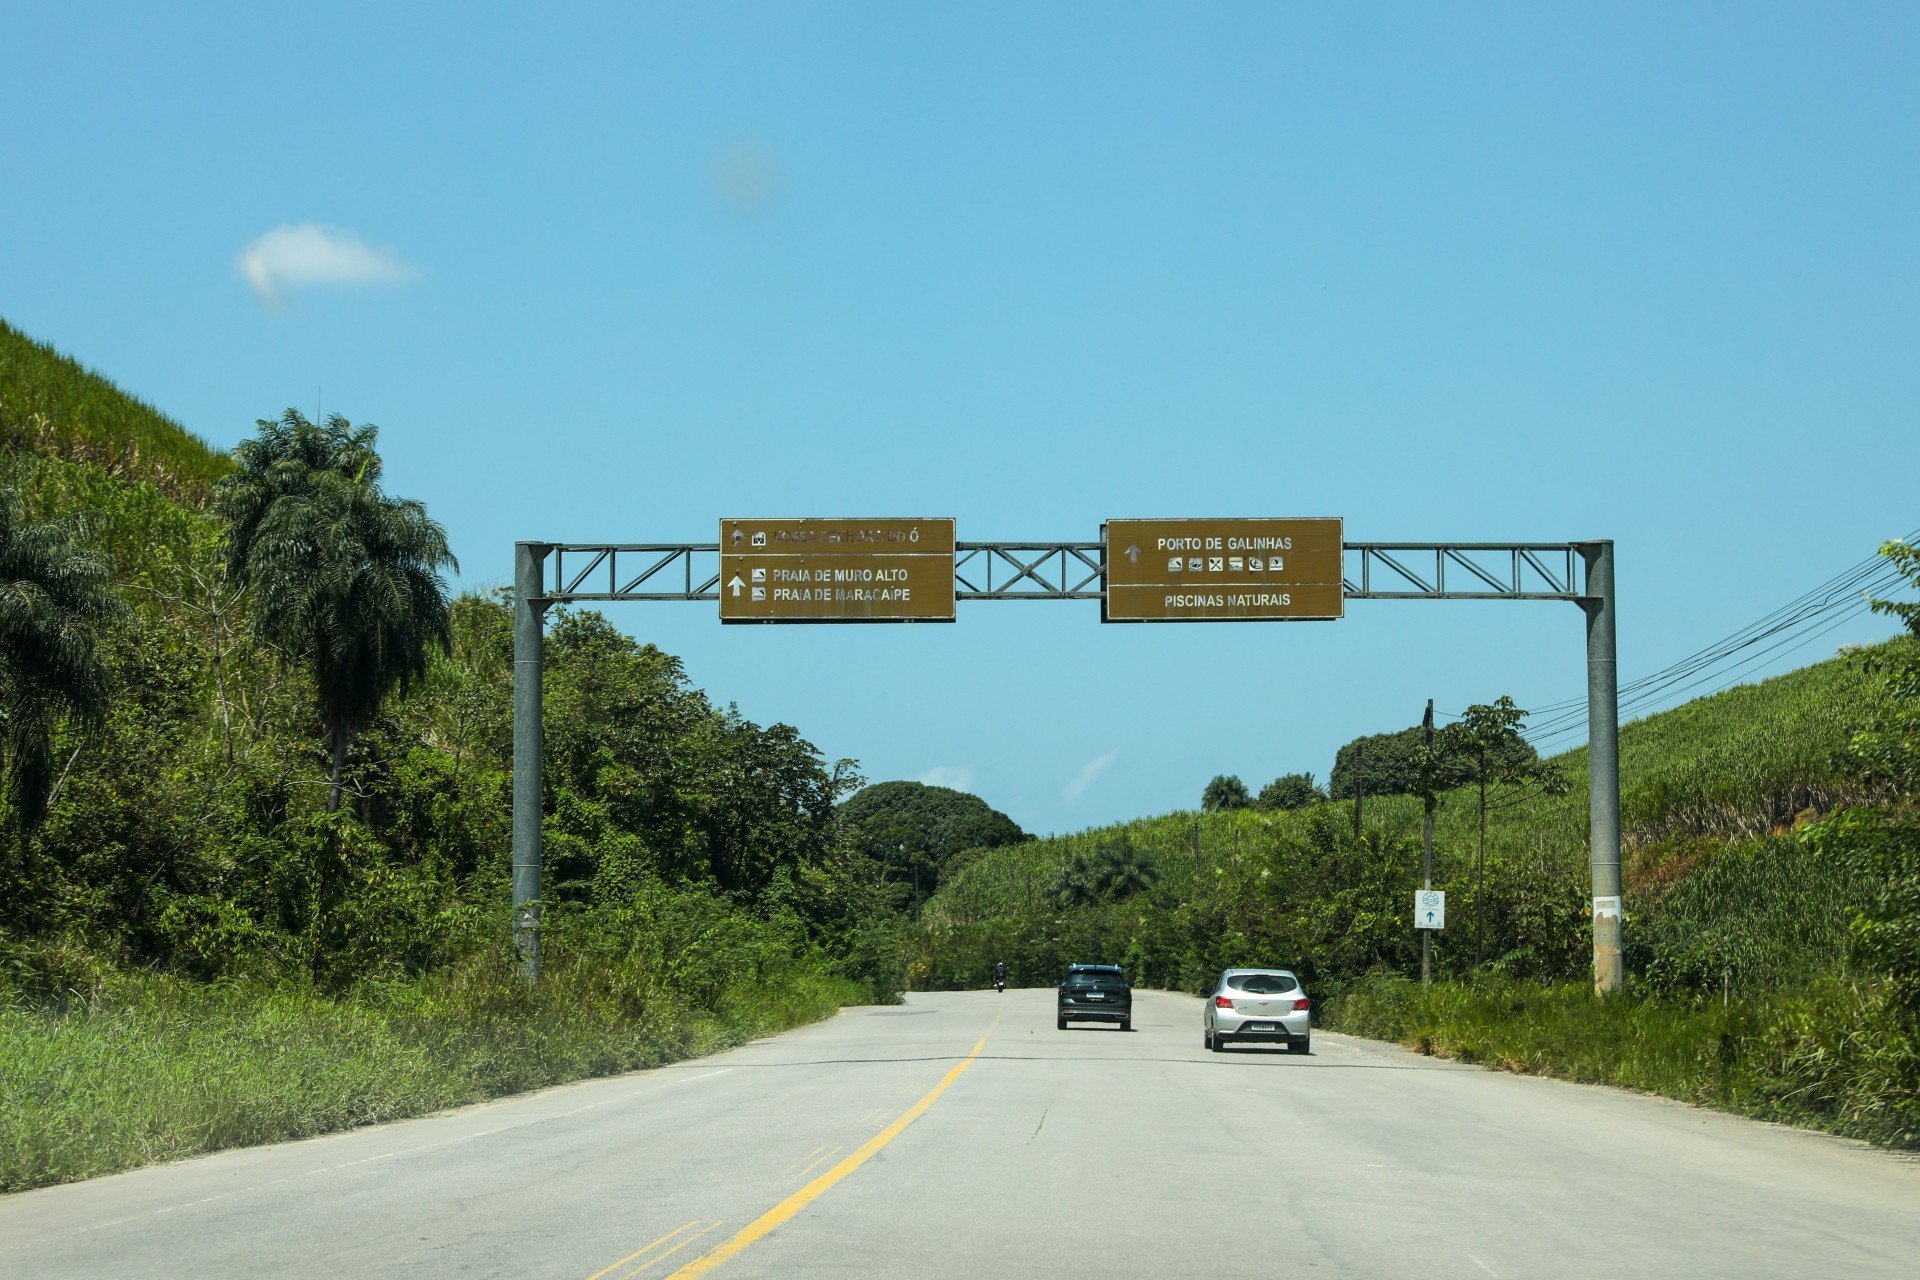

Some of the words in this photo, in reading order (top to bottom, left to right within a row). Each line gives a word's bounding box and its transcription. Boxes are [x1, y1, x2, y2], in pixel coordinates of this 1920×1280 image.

[888, 530, 906, 542] DO
[909, 527, 919, 542] Ó
[1158, 538, 1201, 550] PORTO
[1205, 538, 1222, 550] DE
[1228, 537, 1292, 550] GALINHAS
[773, 569, 811, 581] PRAIA
[815, 569, 831, 581] DE
[834, 569, 872, 581] MURO
[875, 569, 908, 581] ALTO
[773, 588, 811, 600] PRAIA
[815, 588, 831, 600] DE
[835, 586, 911, 600] MARACAÍPE
[1164, 595, 1224, 607] PISCINAS
[1227, 594, 1291, 606] NATURAIS
